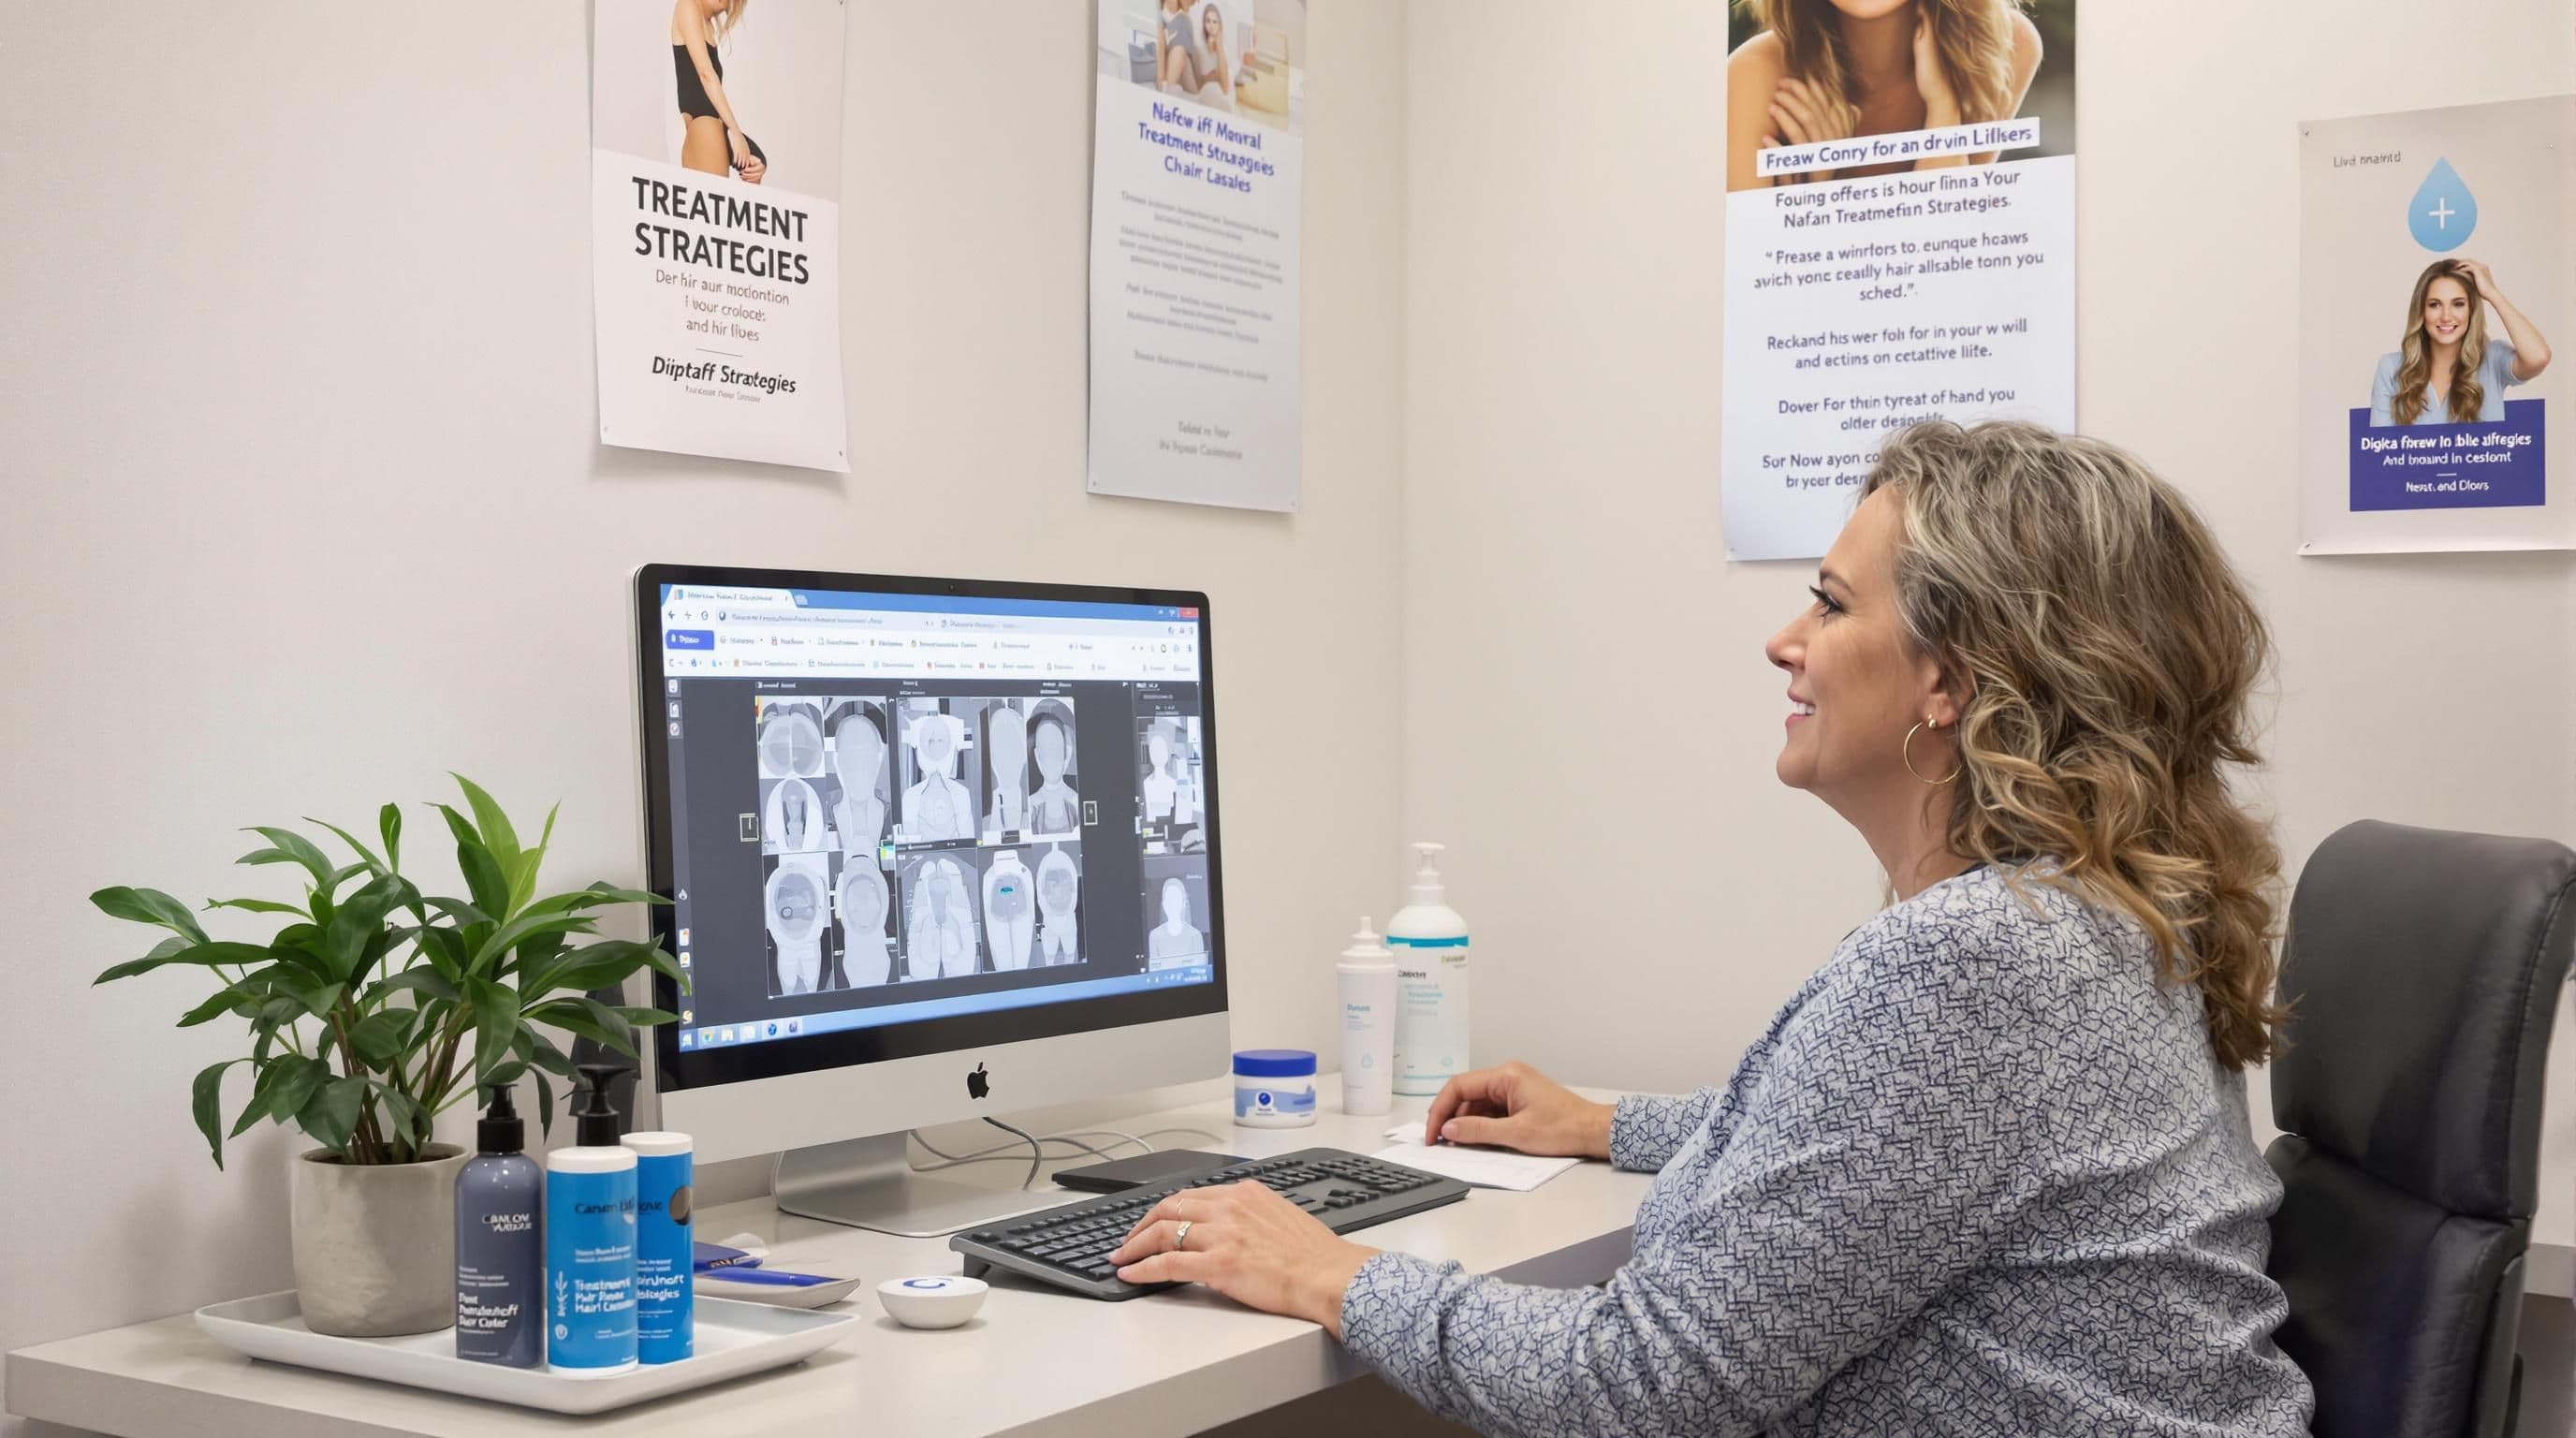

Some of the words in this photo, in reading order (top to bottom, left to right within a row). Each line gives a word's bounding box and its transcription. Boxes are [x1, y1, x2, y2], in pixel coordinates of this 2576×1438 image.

[1138, 122, 1203, 155] Treatment
[1819, 147, 1868, 163] Conry
[1872, 139, 1895, 157] for
[1900, 139, 1920, 154] an
[1830, 183, 1878, 202] offers
[1882, 180, 1895, 197] is
[1899, 178, 1935, 196] hour
[1983, 171, 2021, 186] Your
[632, 175, 808, 242] TREATMENT
[635, 222, 810, 285] STRATEGIES
[1826, 252, 1834, 261] a
[1886, 262, 1914, 276] hair
[2016, 253, 2044, 267] you
[655, 270, 678, 286] Der
[686, 319, 709, 333] and
[1767, 331, 1825, 351] Reckand
[1852, 332, 1878, 345] wer
[1910, 327, 1929, 340] for
[1934, 326, 1946, 339] in
[1950, 324, 1983, 340] your
[2002, 318, 2027, 333] will
[1794, 354, 1821, 370] and
[1873, 352, 1891, 364] on
[1778, 399, 1819, 414] Dover
[1823, 397, 1845, 411] For
[1931, 390, 1946, 405] of
[1988, 389, 2015, 404] you
[1790, 454, 1822, 468] Now
[1826, 452, 1861, 467] ayon
